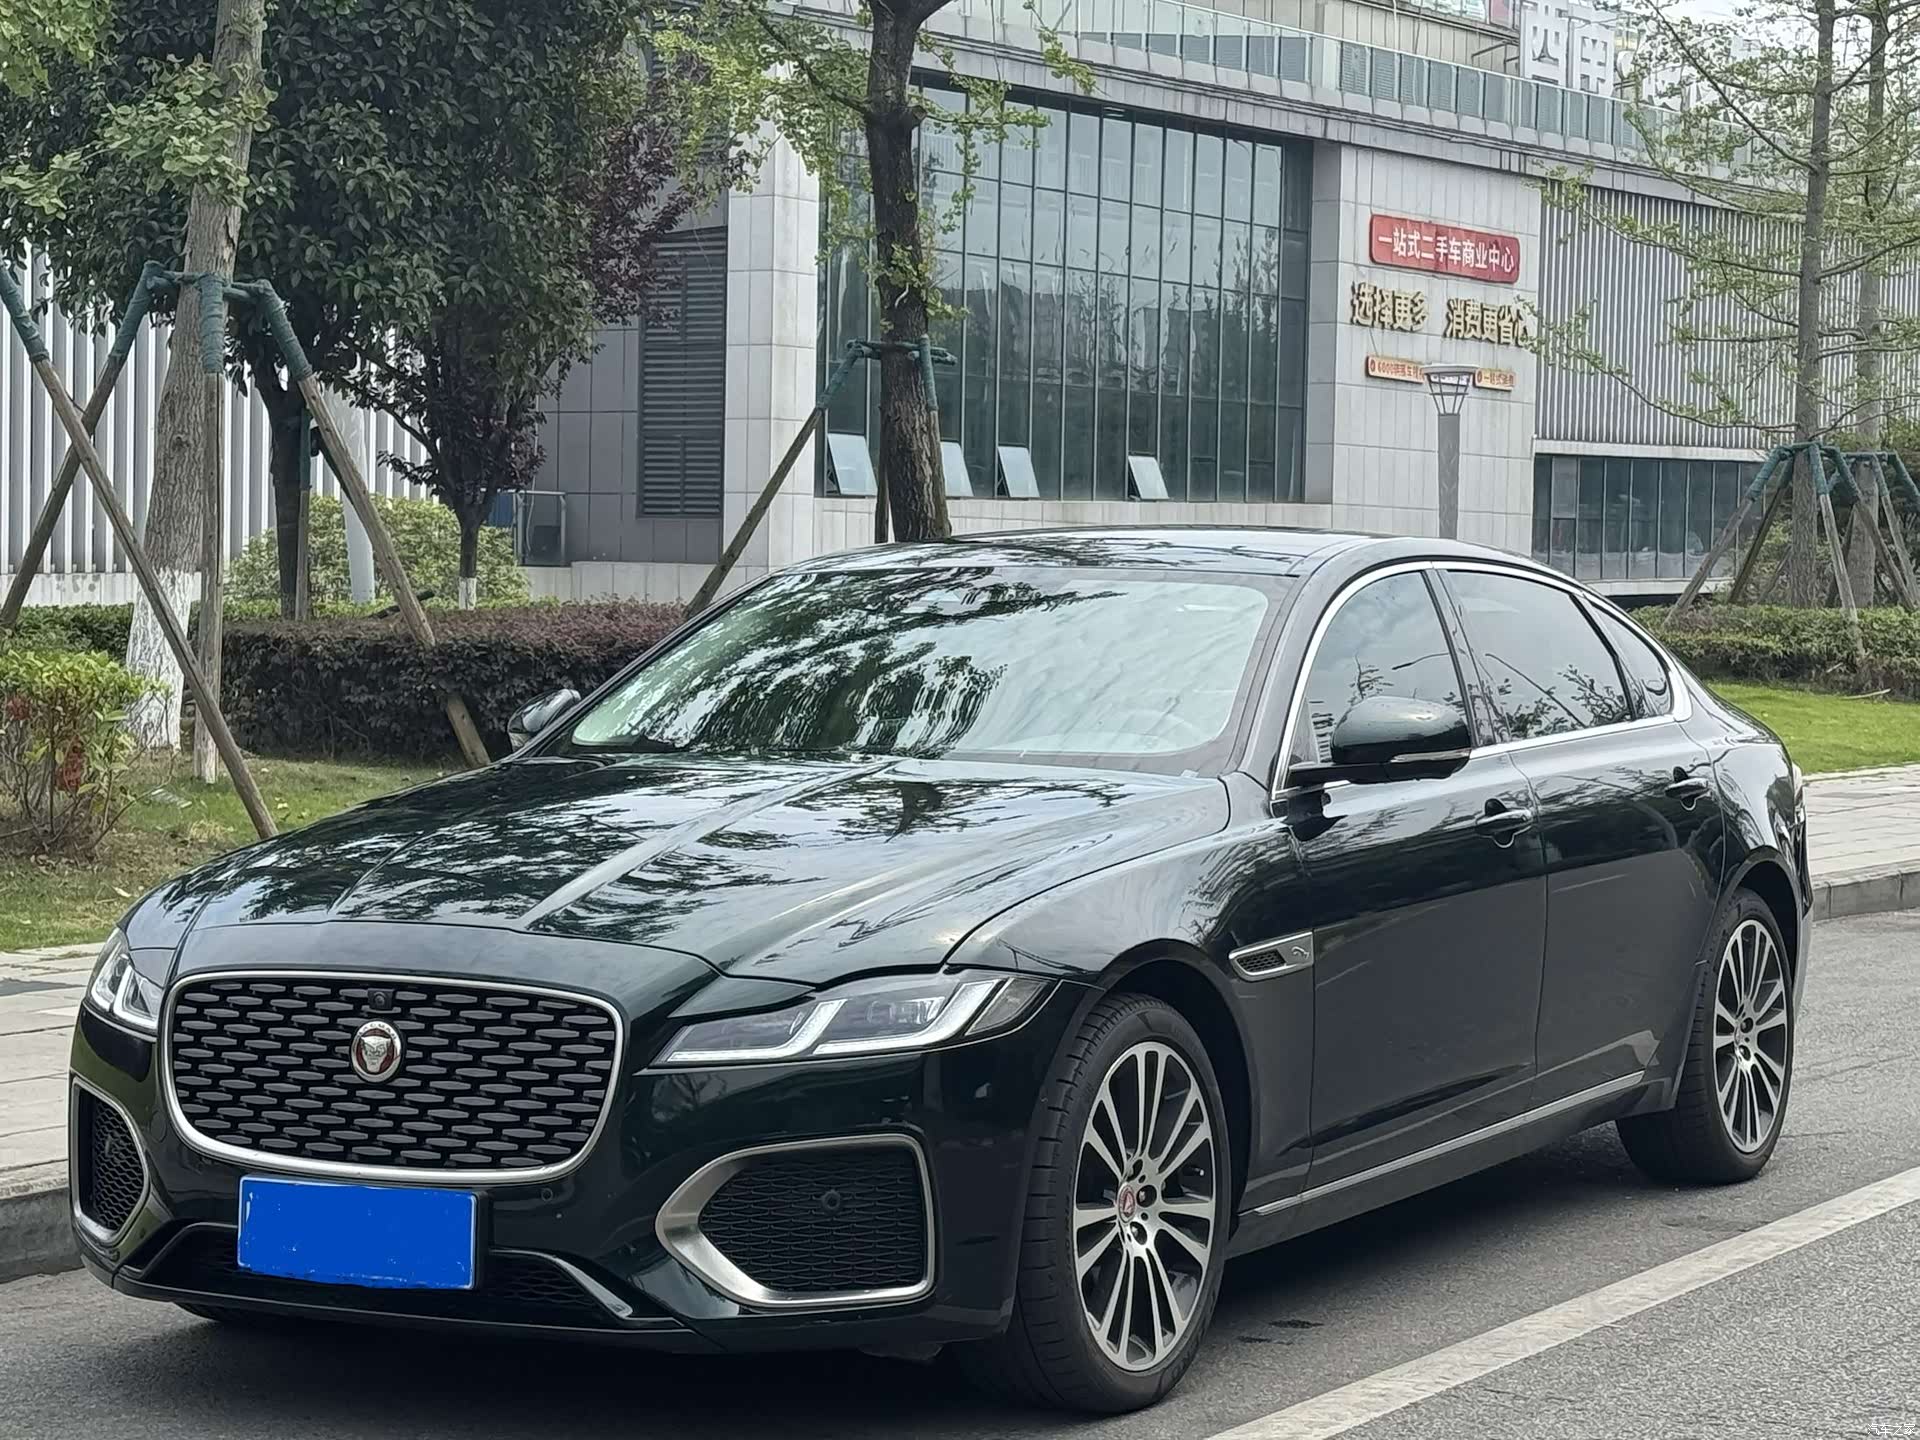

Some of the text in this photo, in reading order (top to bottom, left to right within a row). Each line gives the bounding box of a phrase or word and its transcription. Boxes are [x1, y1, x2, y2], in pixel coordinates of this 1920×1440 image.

[1378, 227, 1515, 273] 一站式二手车商业中心
[1352, 282, 1429, 332] 选择更多
